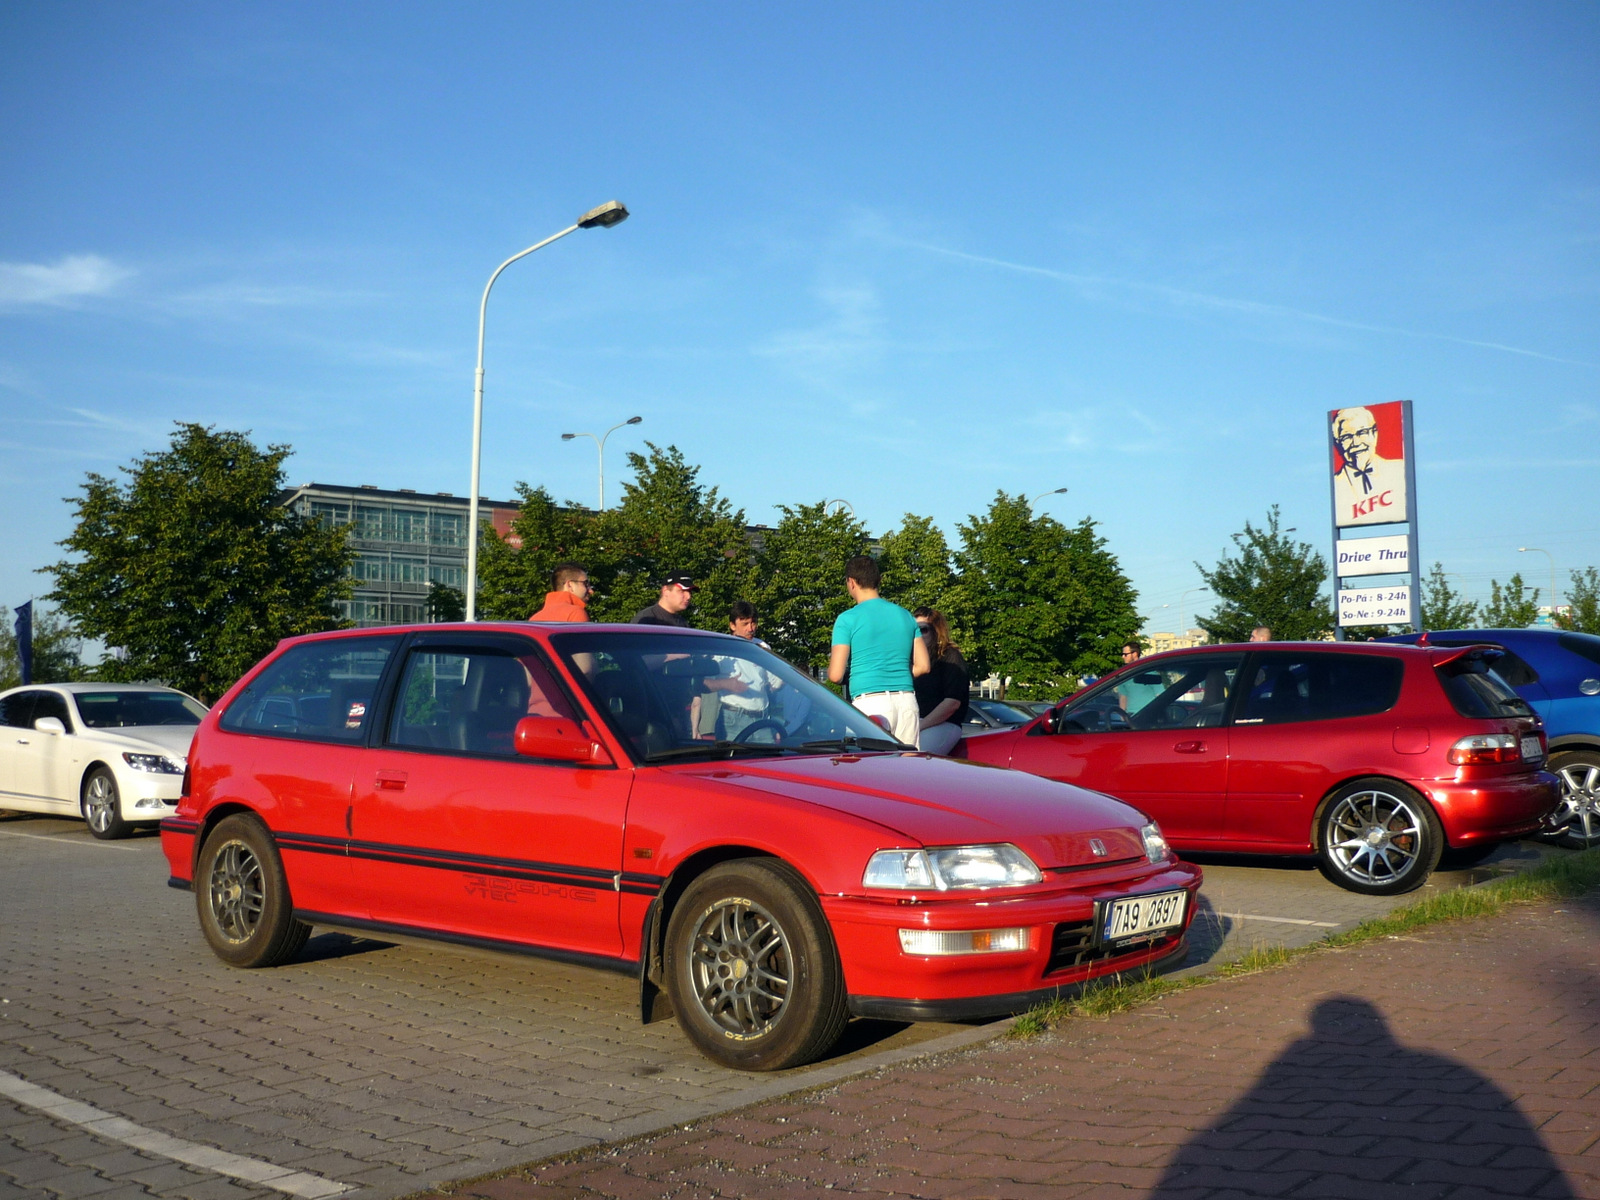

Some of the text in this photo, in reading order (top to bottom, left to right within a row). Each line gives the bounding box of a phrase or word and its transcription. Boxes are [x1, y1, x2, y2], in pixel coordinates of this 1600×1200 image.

[1352, 490, 1393, 519] KFC
[1339, 548, 1408, 563] Drive Thru
[1377, 608, 1407, 618] 9-24h
[1114, 896, 1179, 934] 7A9 2897
